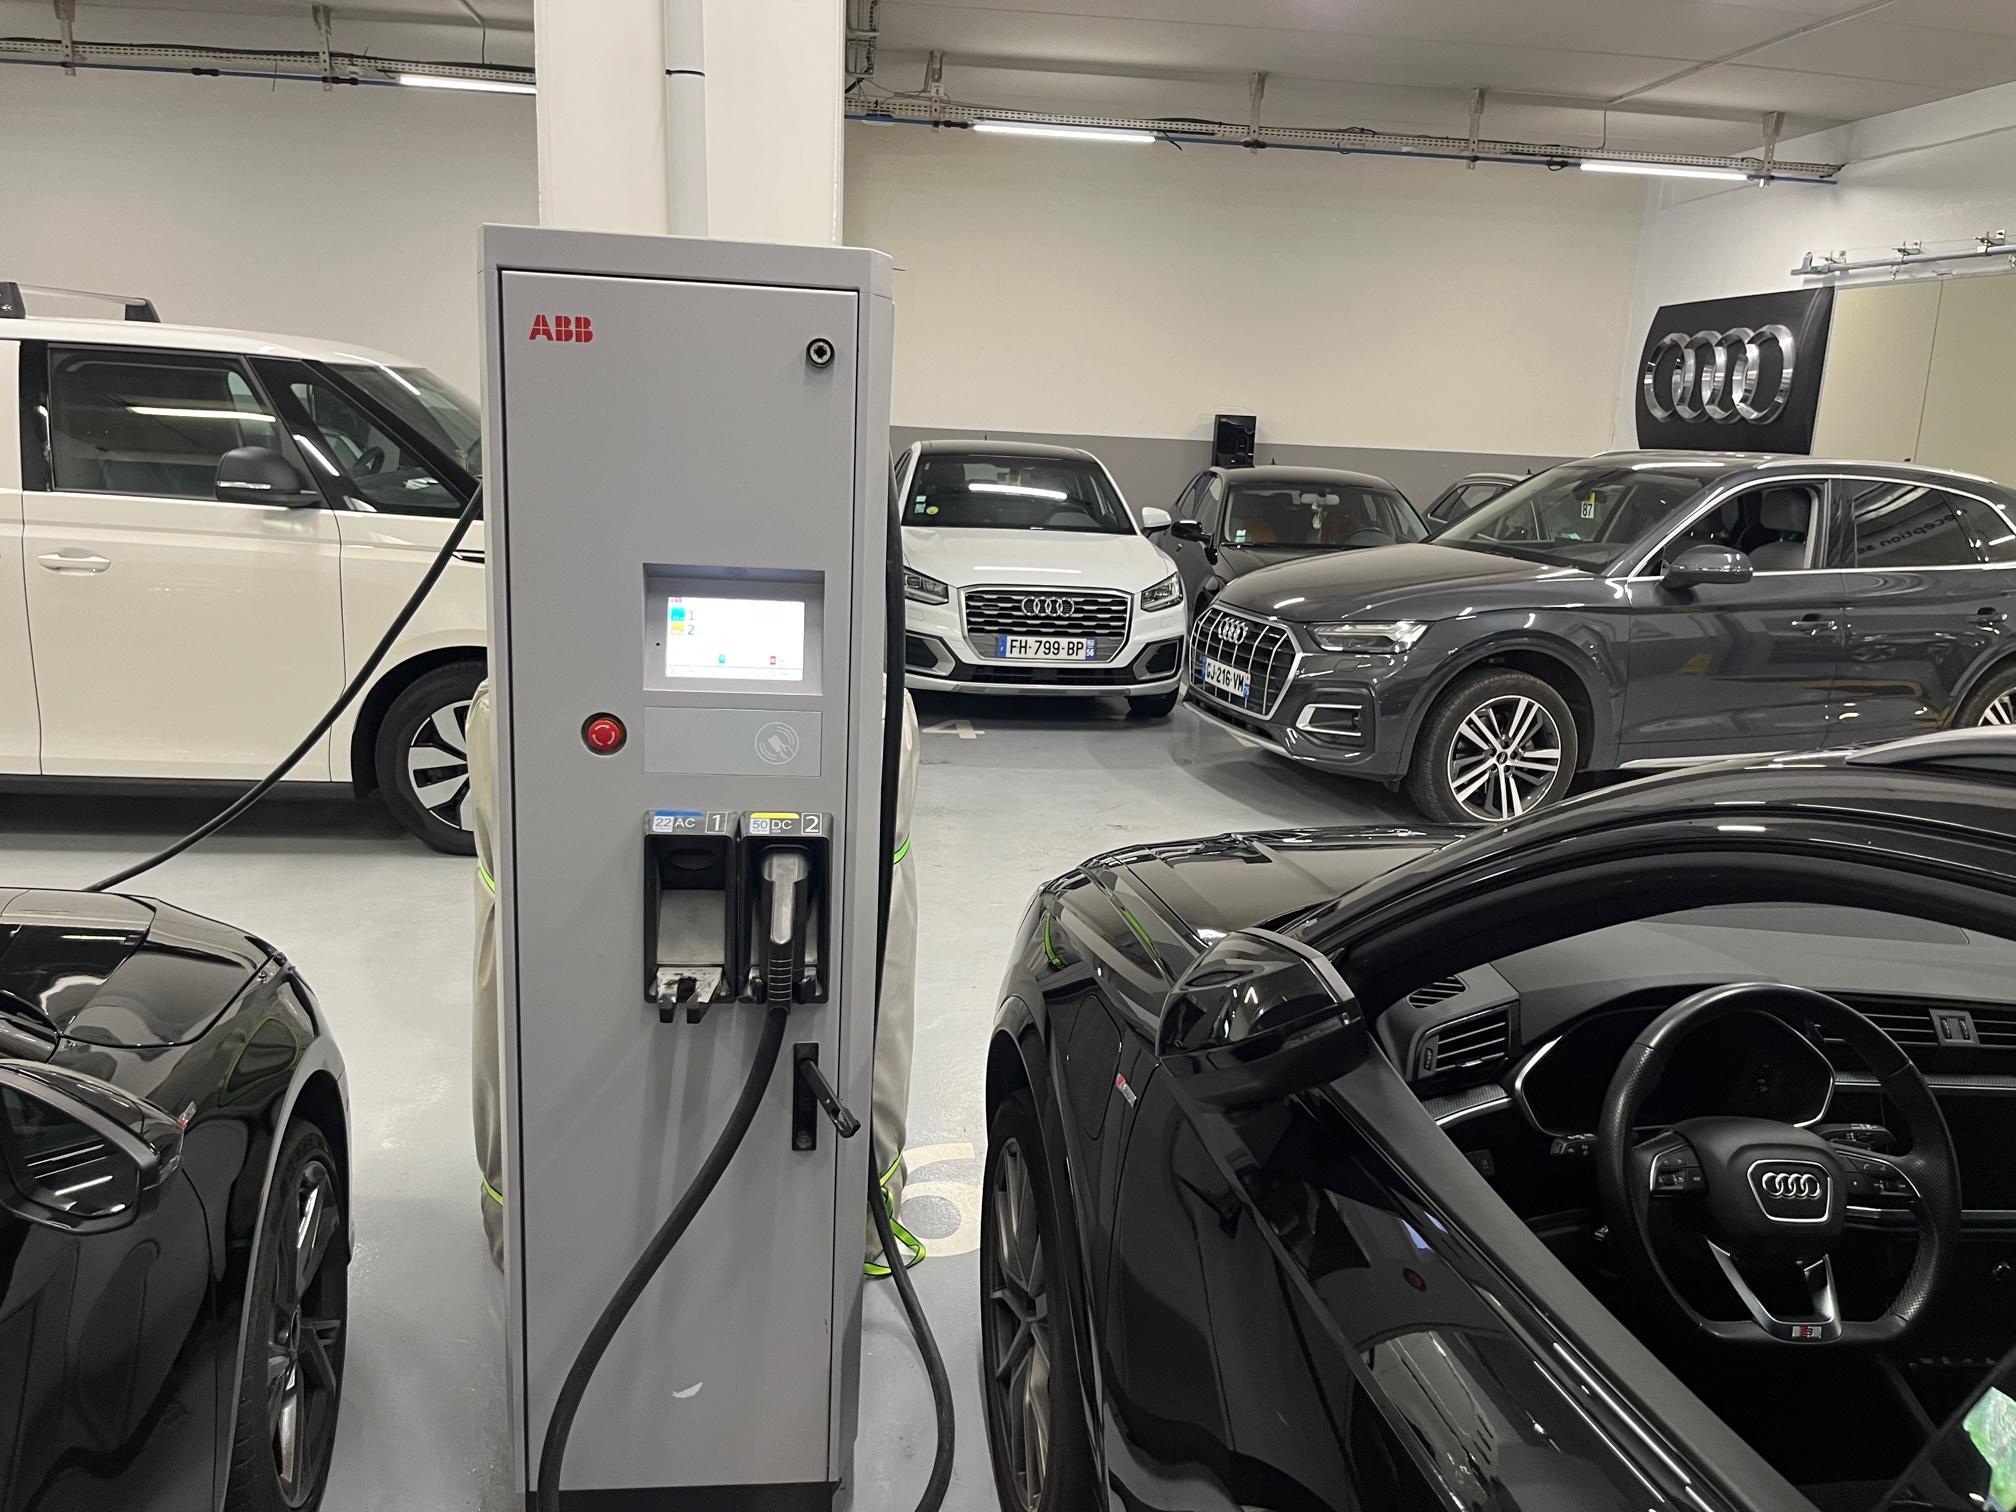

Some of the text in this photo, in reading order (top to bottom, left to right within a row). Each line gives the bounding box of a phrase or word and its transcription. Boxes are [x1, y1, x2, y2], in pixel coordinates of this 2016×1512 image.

[529, 314, 593, 343] ABB
[1582, 502, 1593, 516] 87
[1009, 639, 1084, 657] FH-799-BP
[655, 817, 672, 827] 22
[674, 817, 696, 828] AC
[752, 815, 819, 833] 50 DC 2
